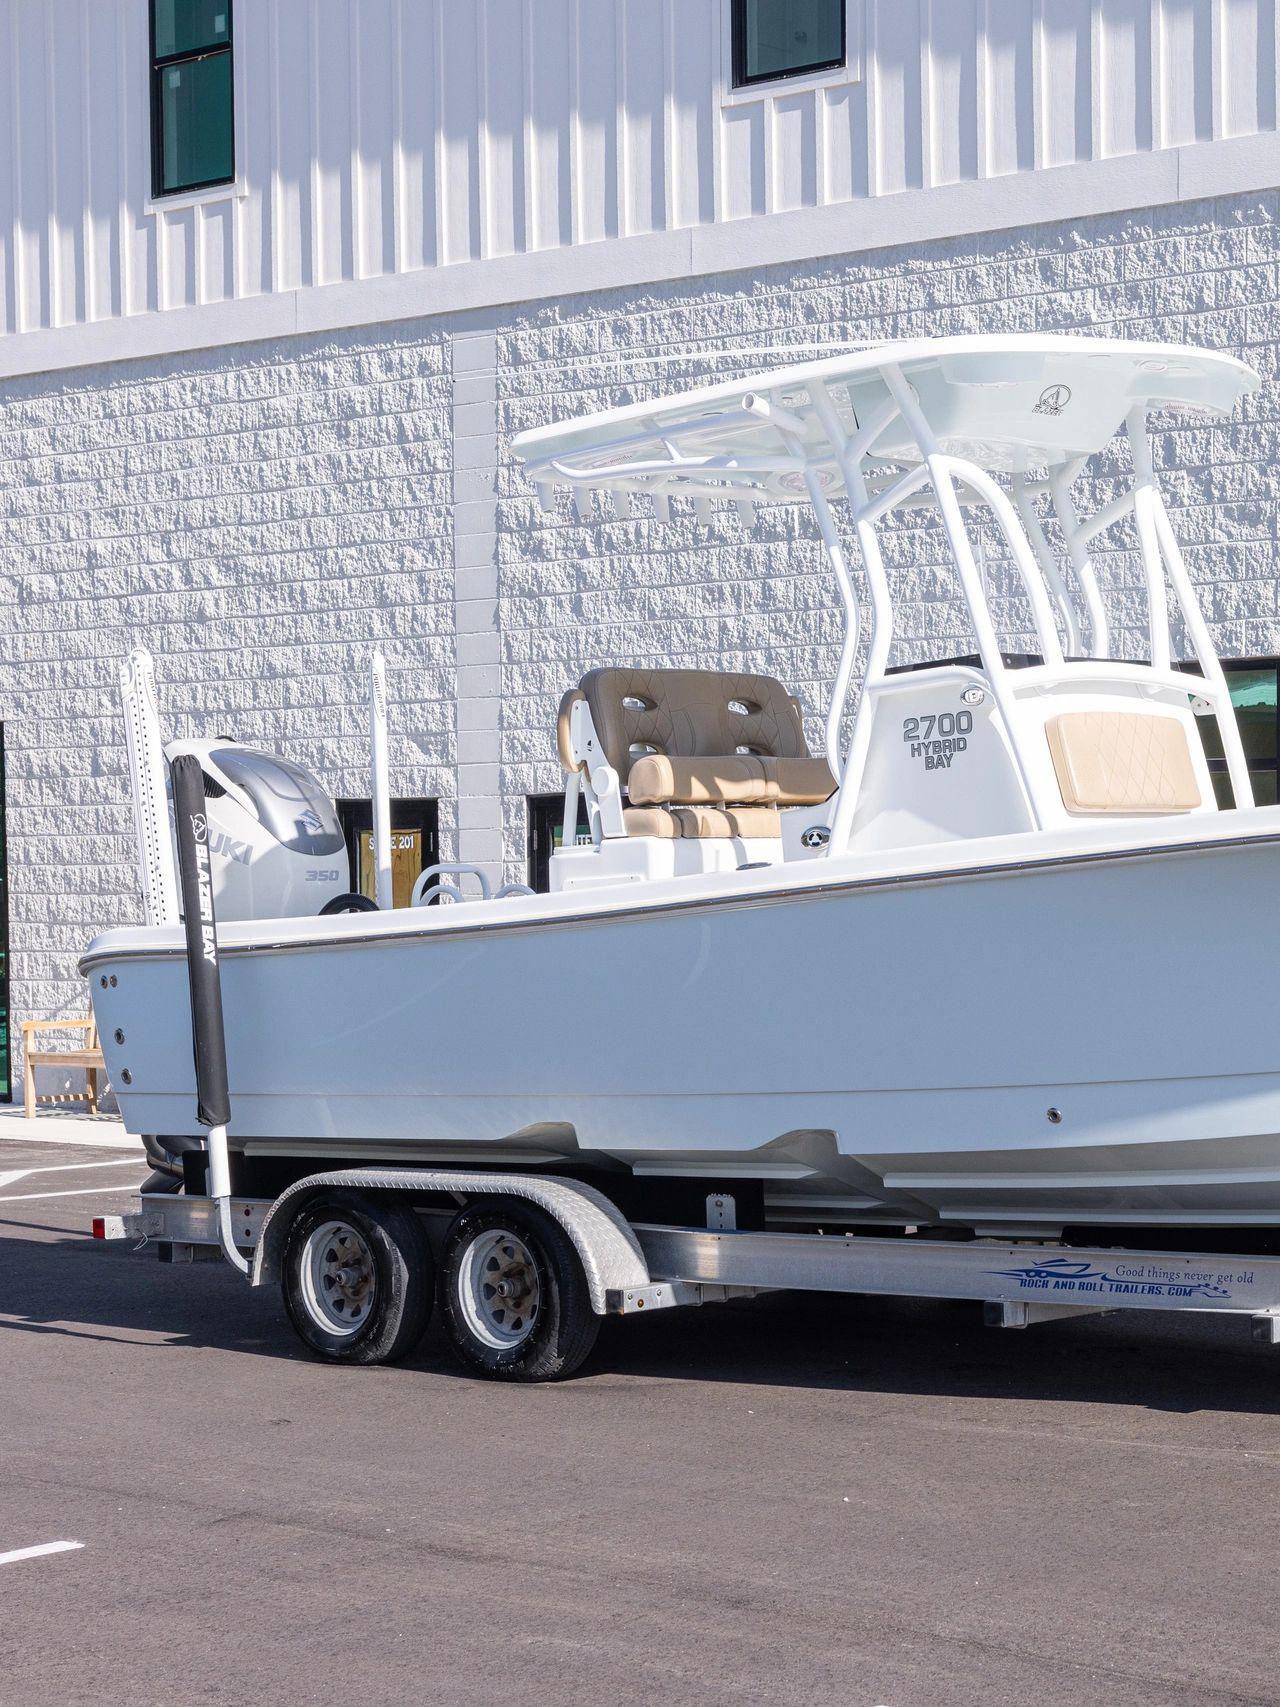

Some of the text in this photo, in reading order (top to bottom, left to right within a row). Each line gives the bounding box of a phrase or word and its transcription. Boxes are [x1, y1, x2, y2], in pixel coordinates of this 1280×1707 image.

[903, 710, 973, 742] 2700
[911, 737, 967, 757] HYBRID
[925, 753, 953, 770] BAY
[399, 836, 414, 849] 201
[305, 870, 340, 881] 350
[195, 844, 217, 966] BLAZER BAY
[1115, 1264, 1253, 1284] Good things never get old
[1020, 1279, 1049, 1289] ROCK
[1053, 1280, 1075, 1290] AND
[1078, 1281, 1105, 1292] ROLL
